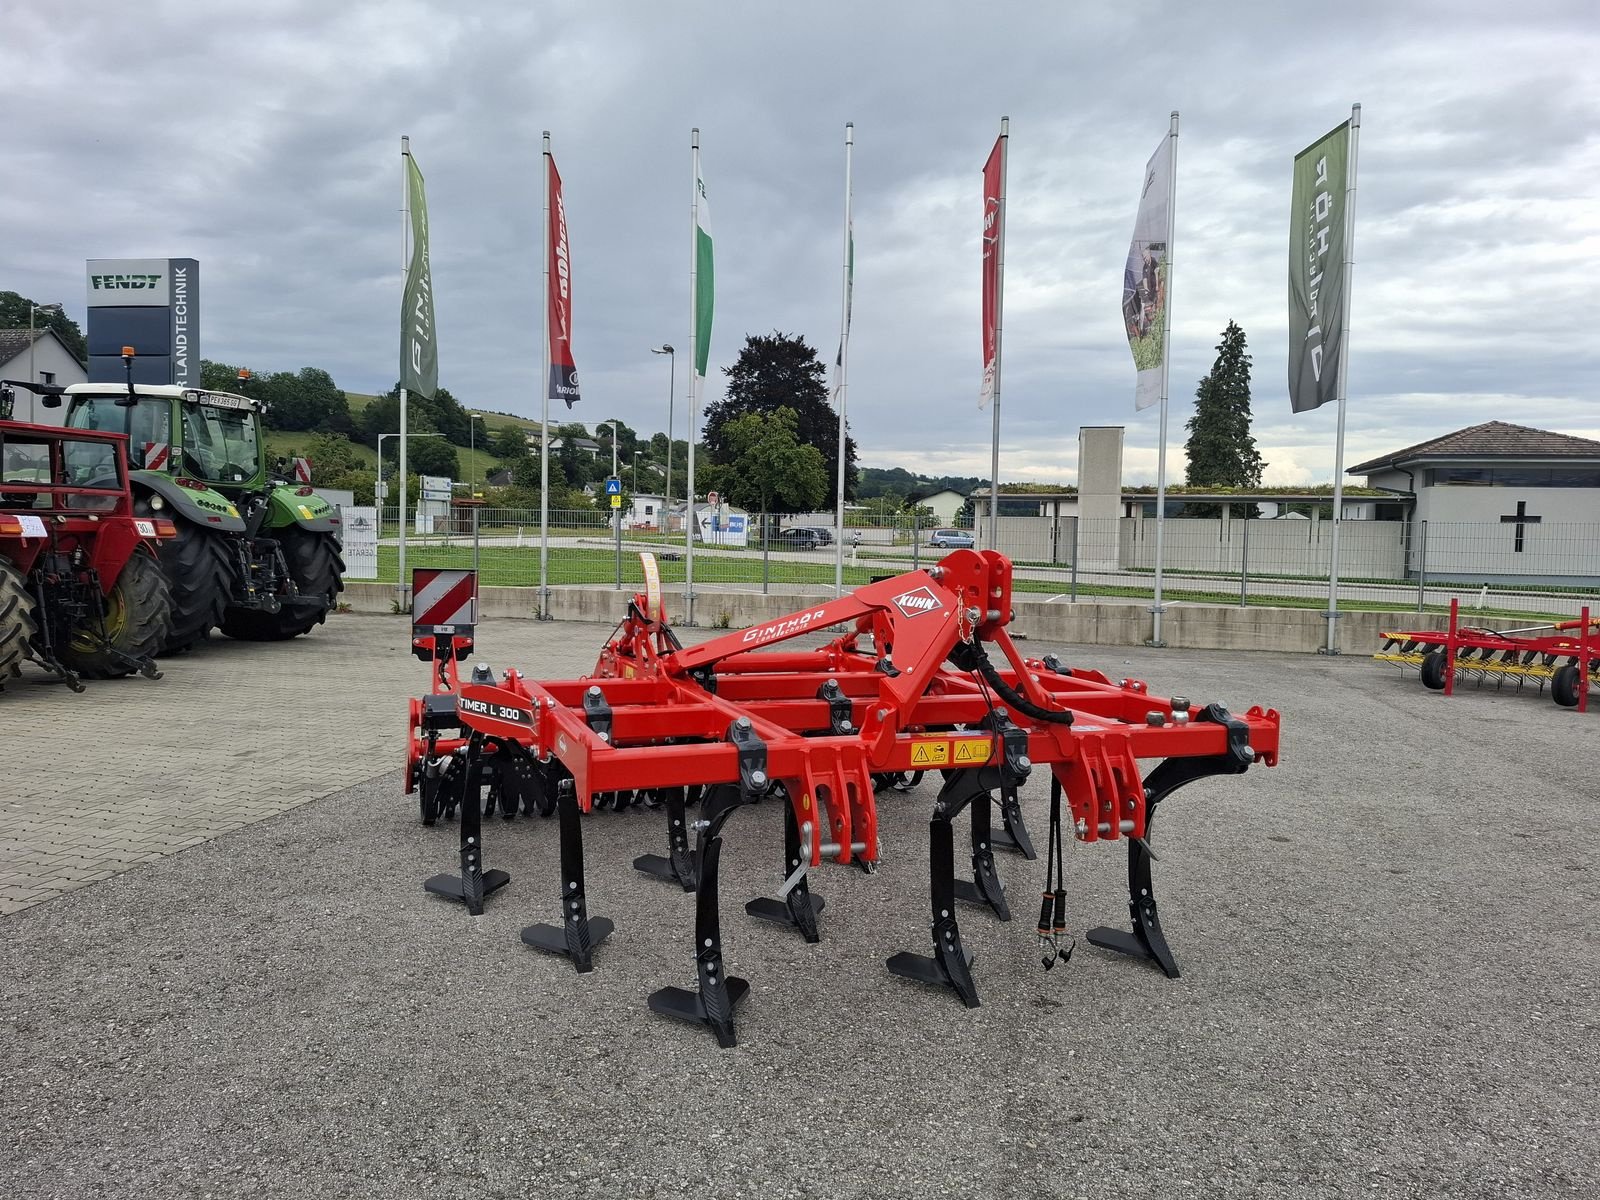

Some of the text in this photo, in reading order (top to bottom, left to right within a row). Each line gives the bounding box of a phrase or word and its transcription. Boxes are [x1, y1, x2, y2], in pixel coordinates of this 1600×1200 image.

[91, 274, 162, 290] FENDT
[175, 267, 188, 377] LANDTECHNIK
[137, 523, 149, 534] 30
[898, 595, 936, 610] KUHN
[743, 609, 825, 643] GINTHÖR
[489, 704, 497, 716] L
[499, 706, 520, 720] 300
